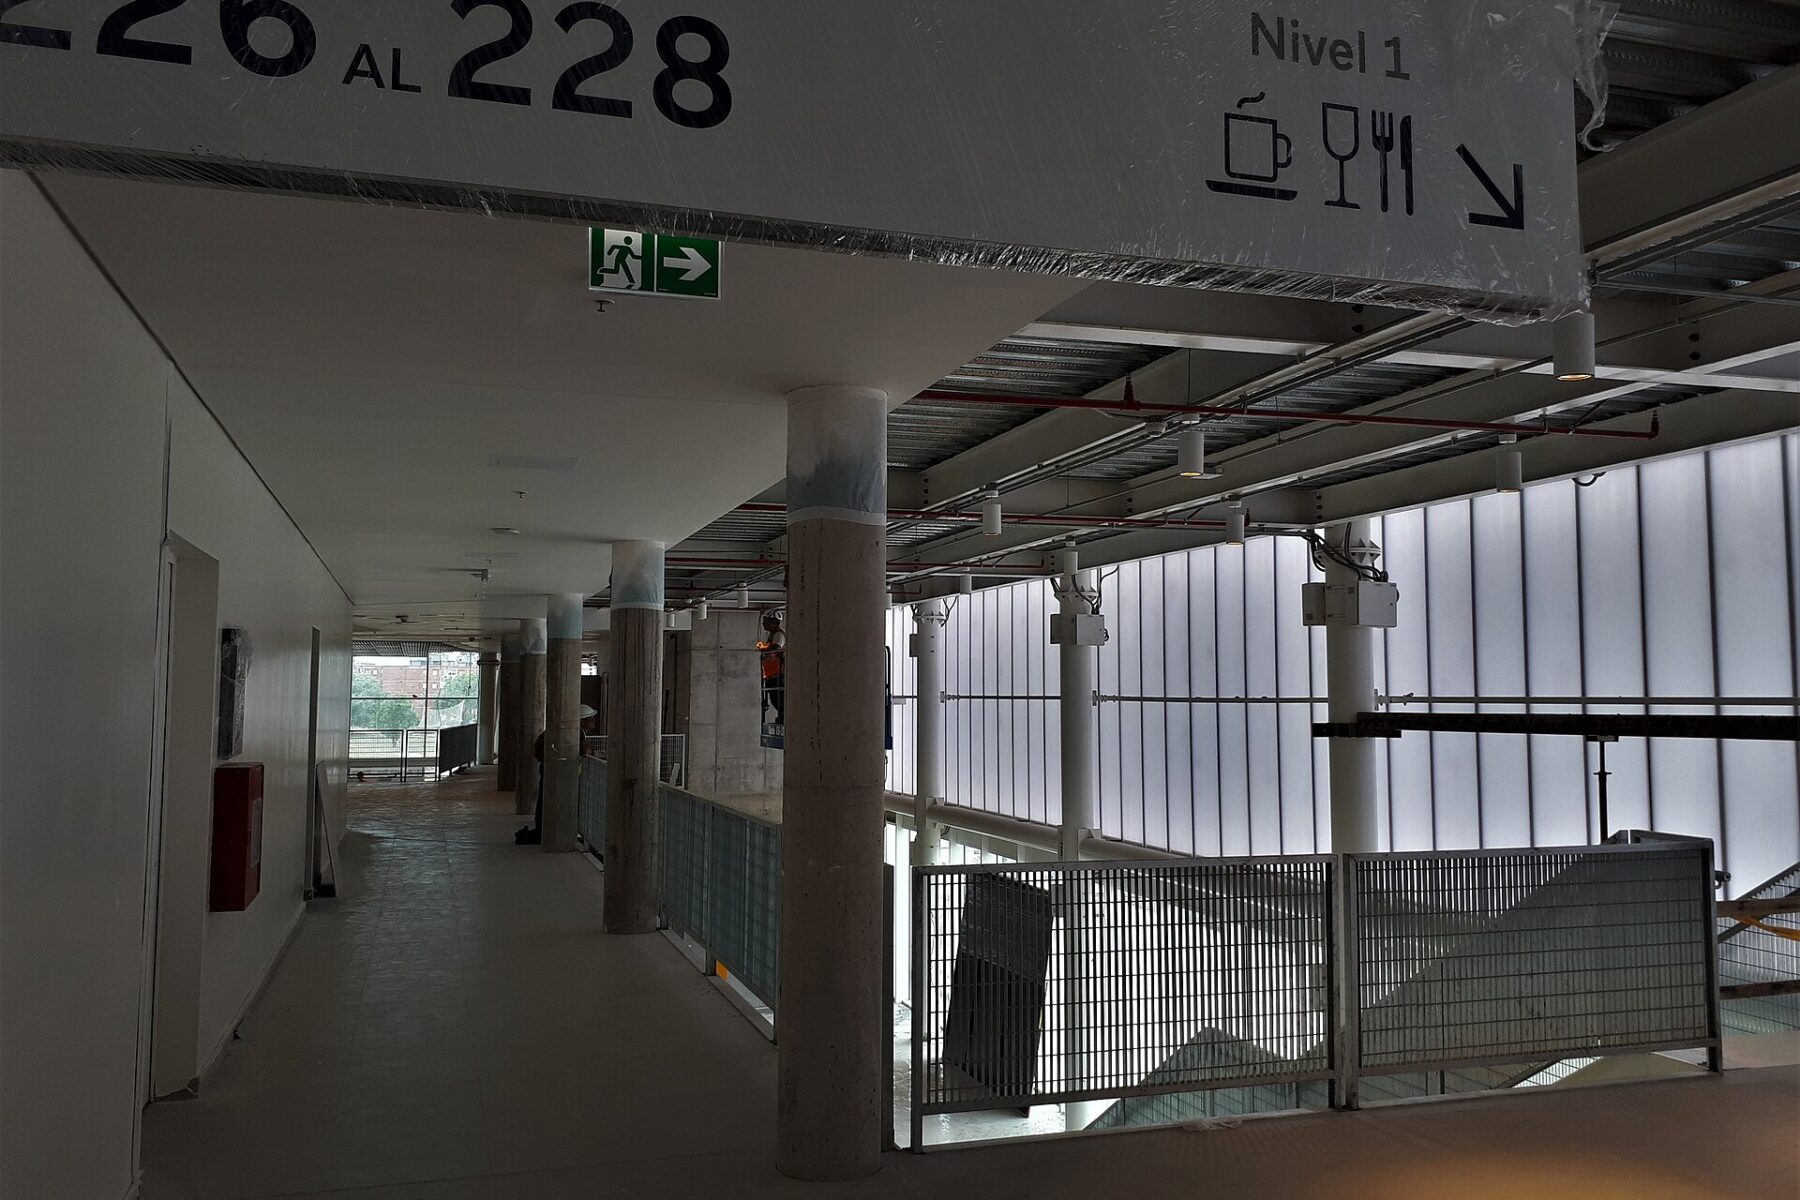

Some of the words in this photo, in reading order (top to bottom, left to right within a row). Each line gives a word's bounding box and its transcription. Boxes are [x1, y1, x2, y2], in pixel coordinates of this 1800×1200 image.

[342, 43, 422, 93] AL
[448, 0, 732, 129] 228
[1251, 12, 1366, 74] Nivel
[1384, 36, 1411, 81] 1
